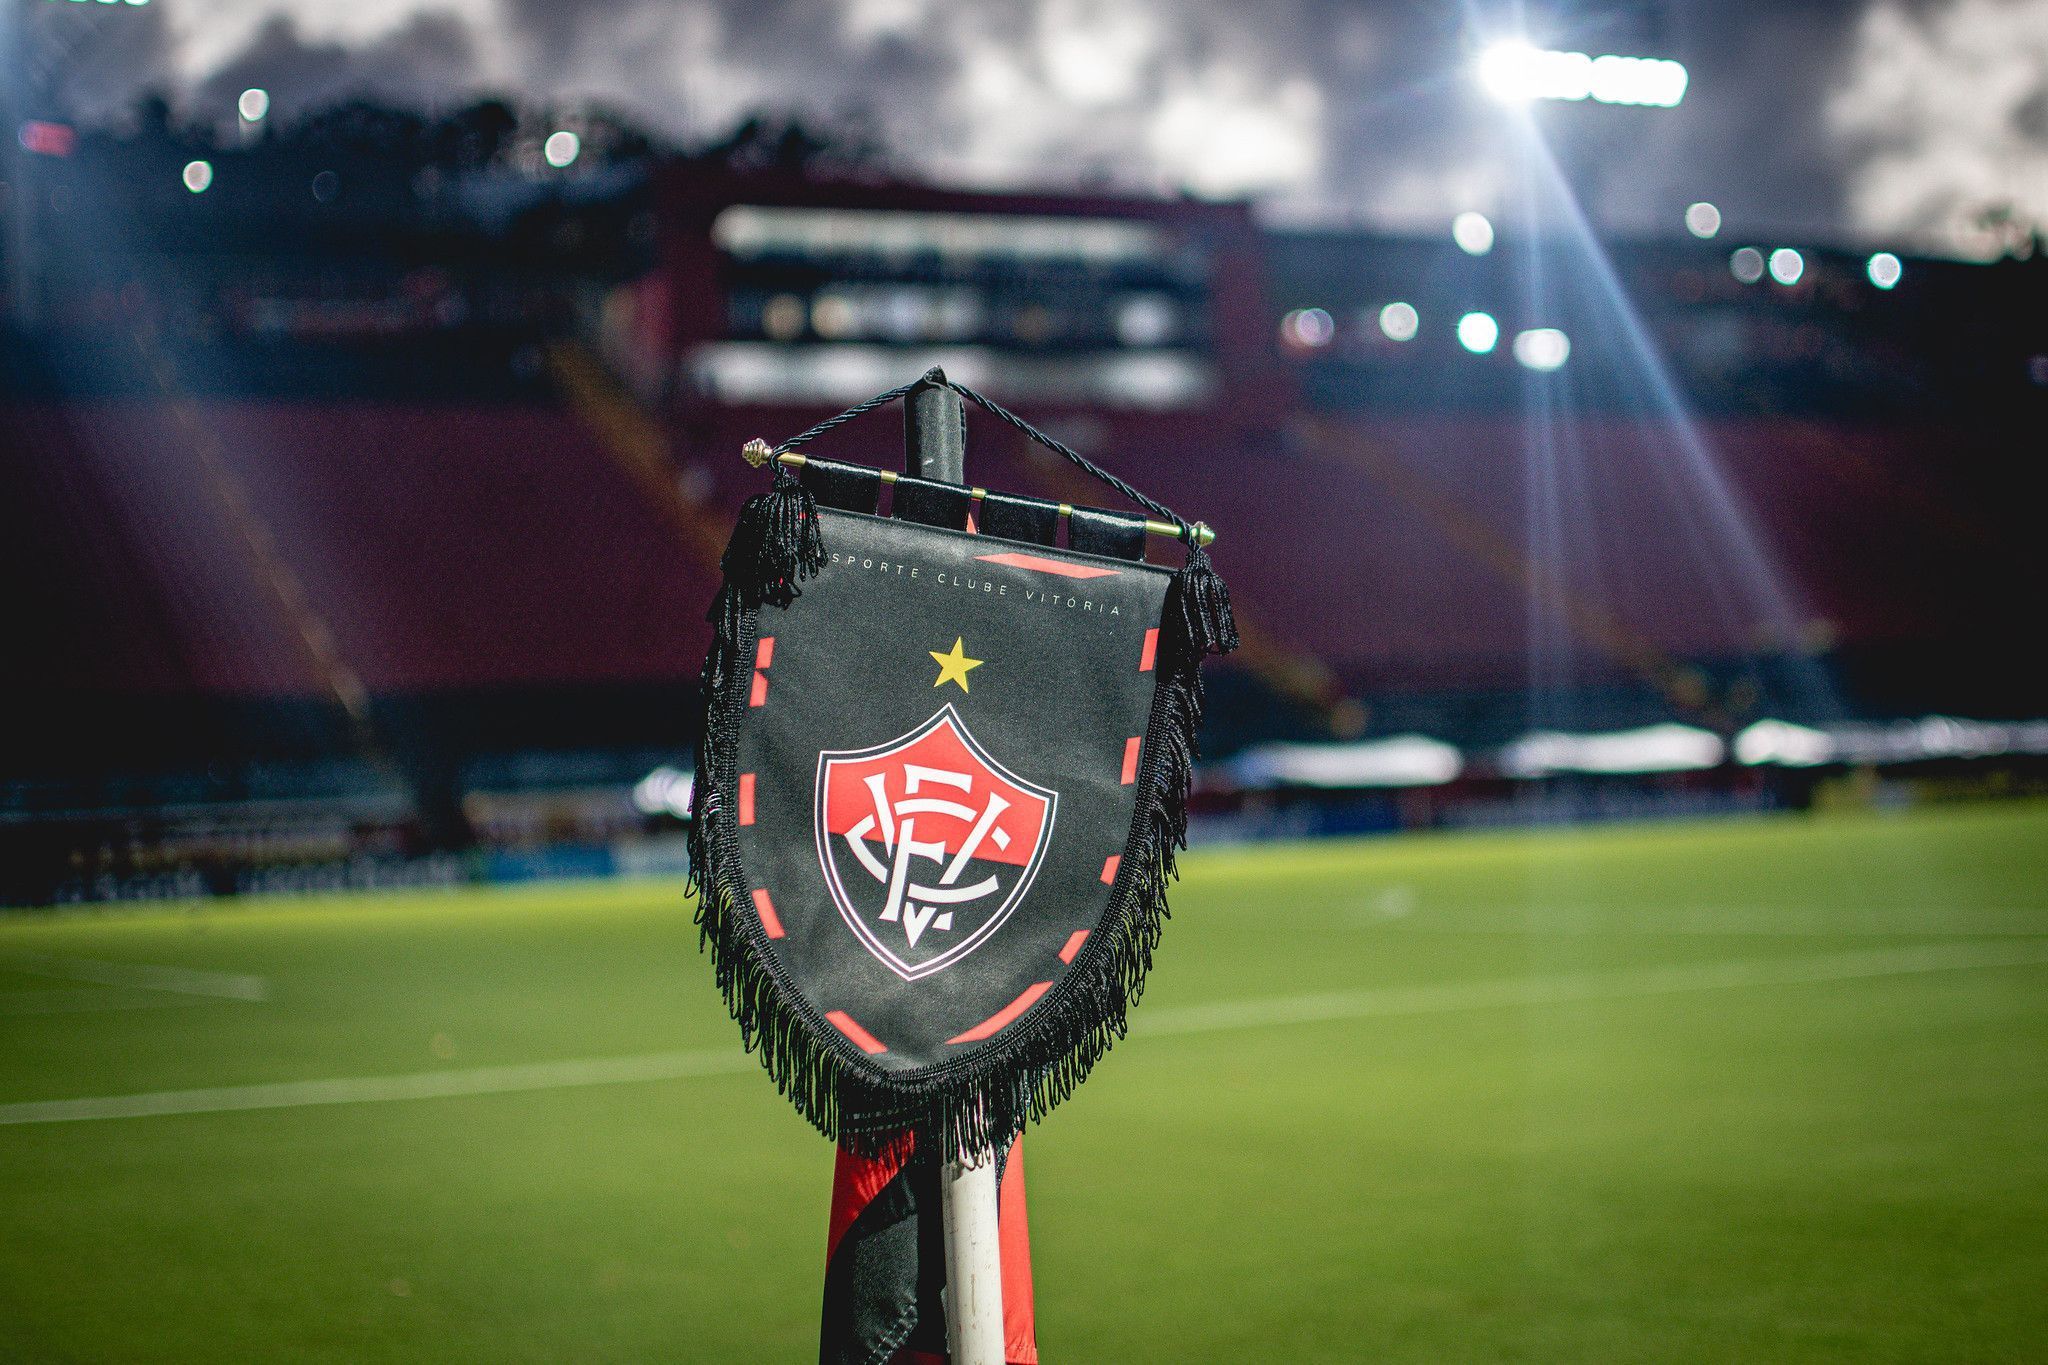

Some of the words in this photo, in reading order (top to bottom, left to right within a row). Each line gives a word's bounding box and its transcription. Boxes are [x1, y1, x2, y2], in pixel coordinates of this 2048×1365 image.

[818, 551, 919, 579] SPORTE
[937, 573, 1007, 595] CLUBE
[1025, 590, 1121, 616] VITÓRIA
